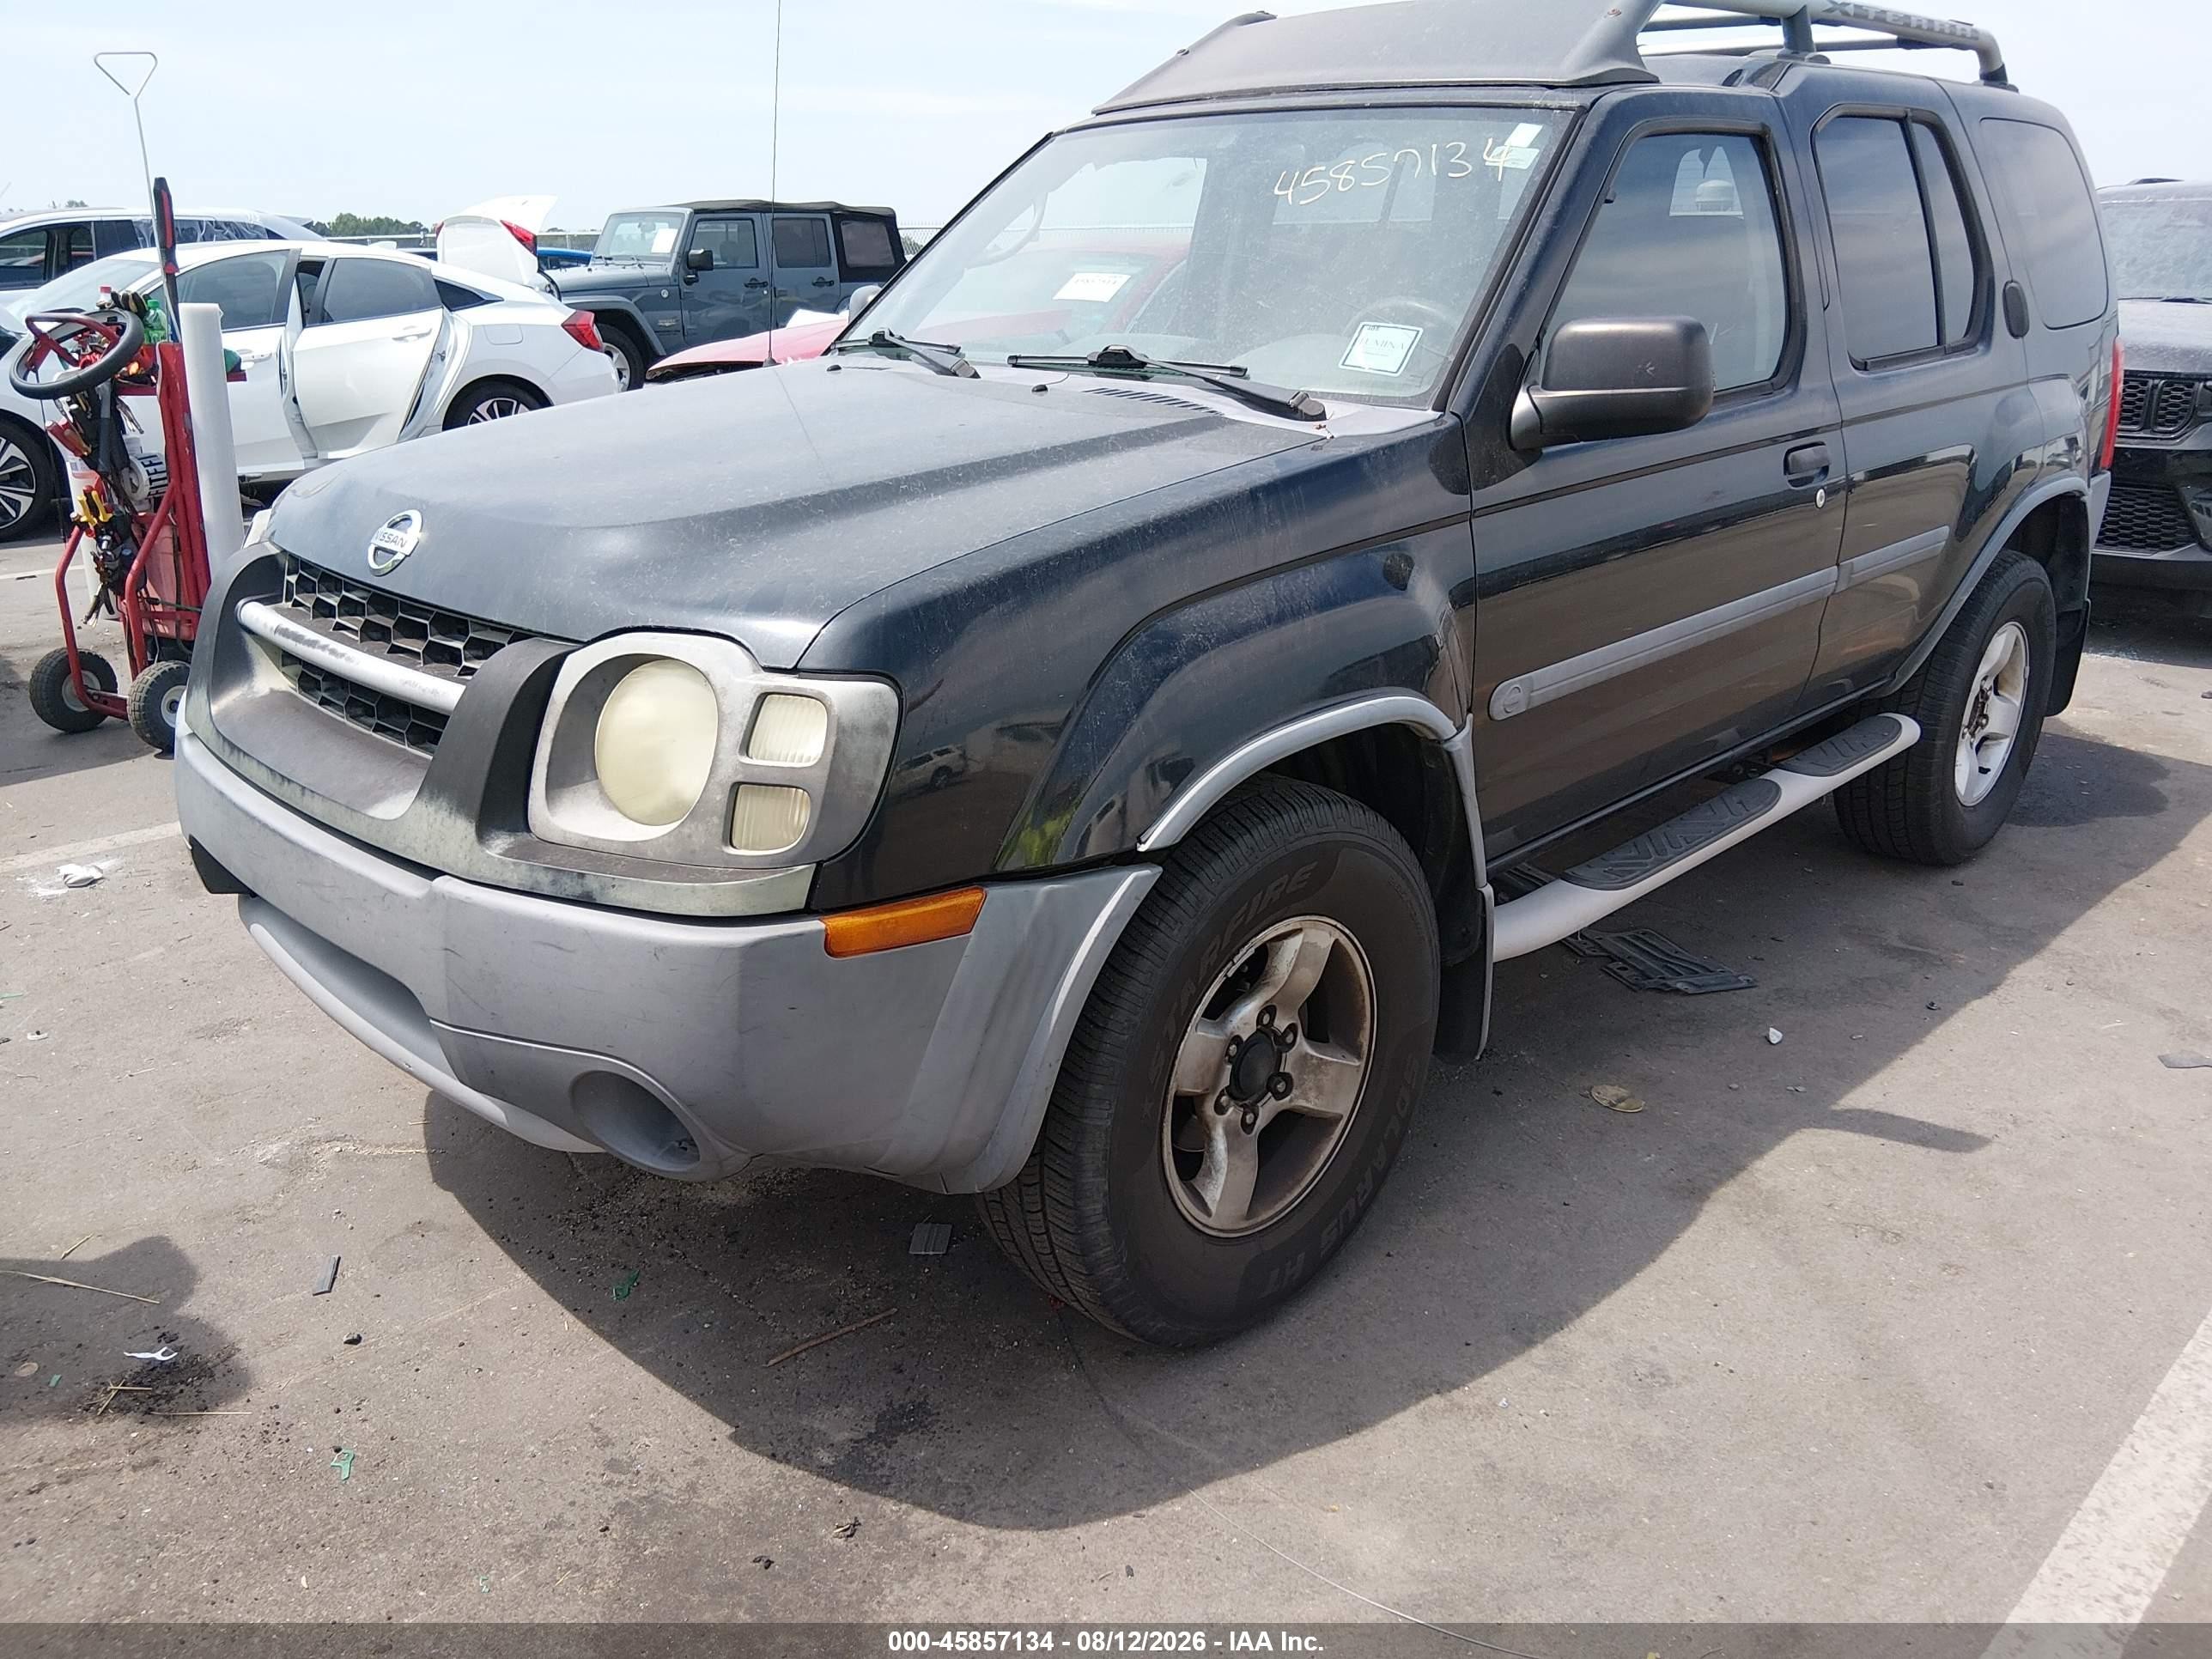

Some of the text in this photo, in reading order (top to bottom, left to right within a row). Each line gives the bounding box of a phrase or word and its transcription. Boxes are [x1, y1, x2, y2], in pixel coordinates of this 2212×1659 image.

[1822, 0, 1975, 39] XTERRA
[1273, 137, 1511, 205] 45857134
[374, 528, 408, 549] NISSAN
[1147, 860, 1318, 1085] STARFIRE
